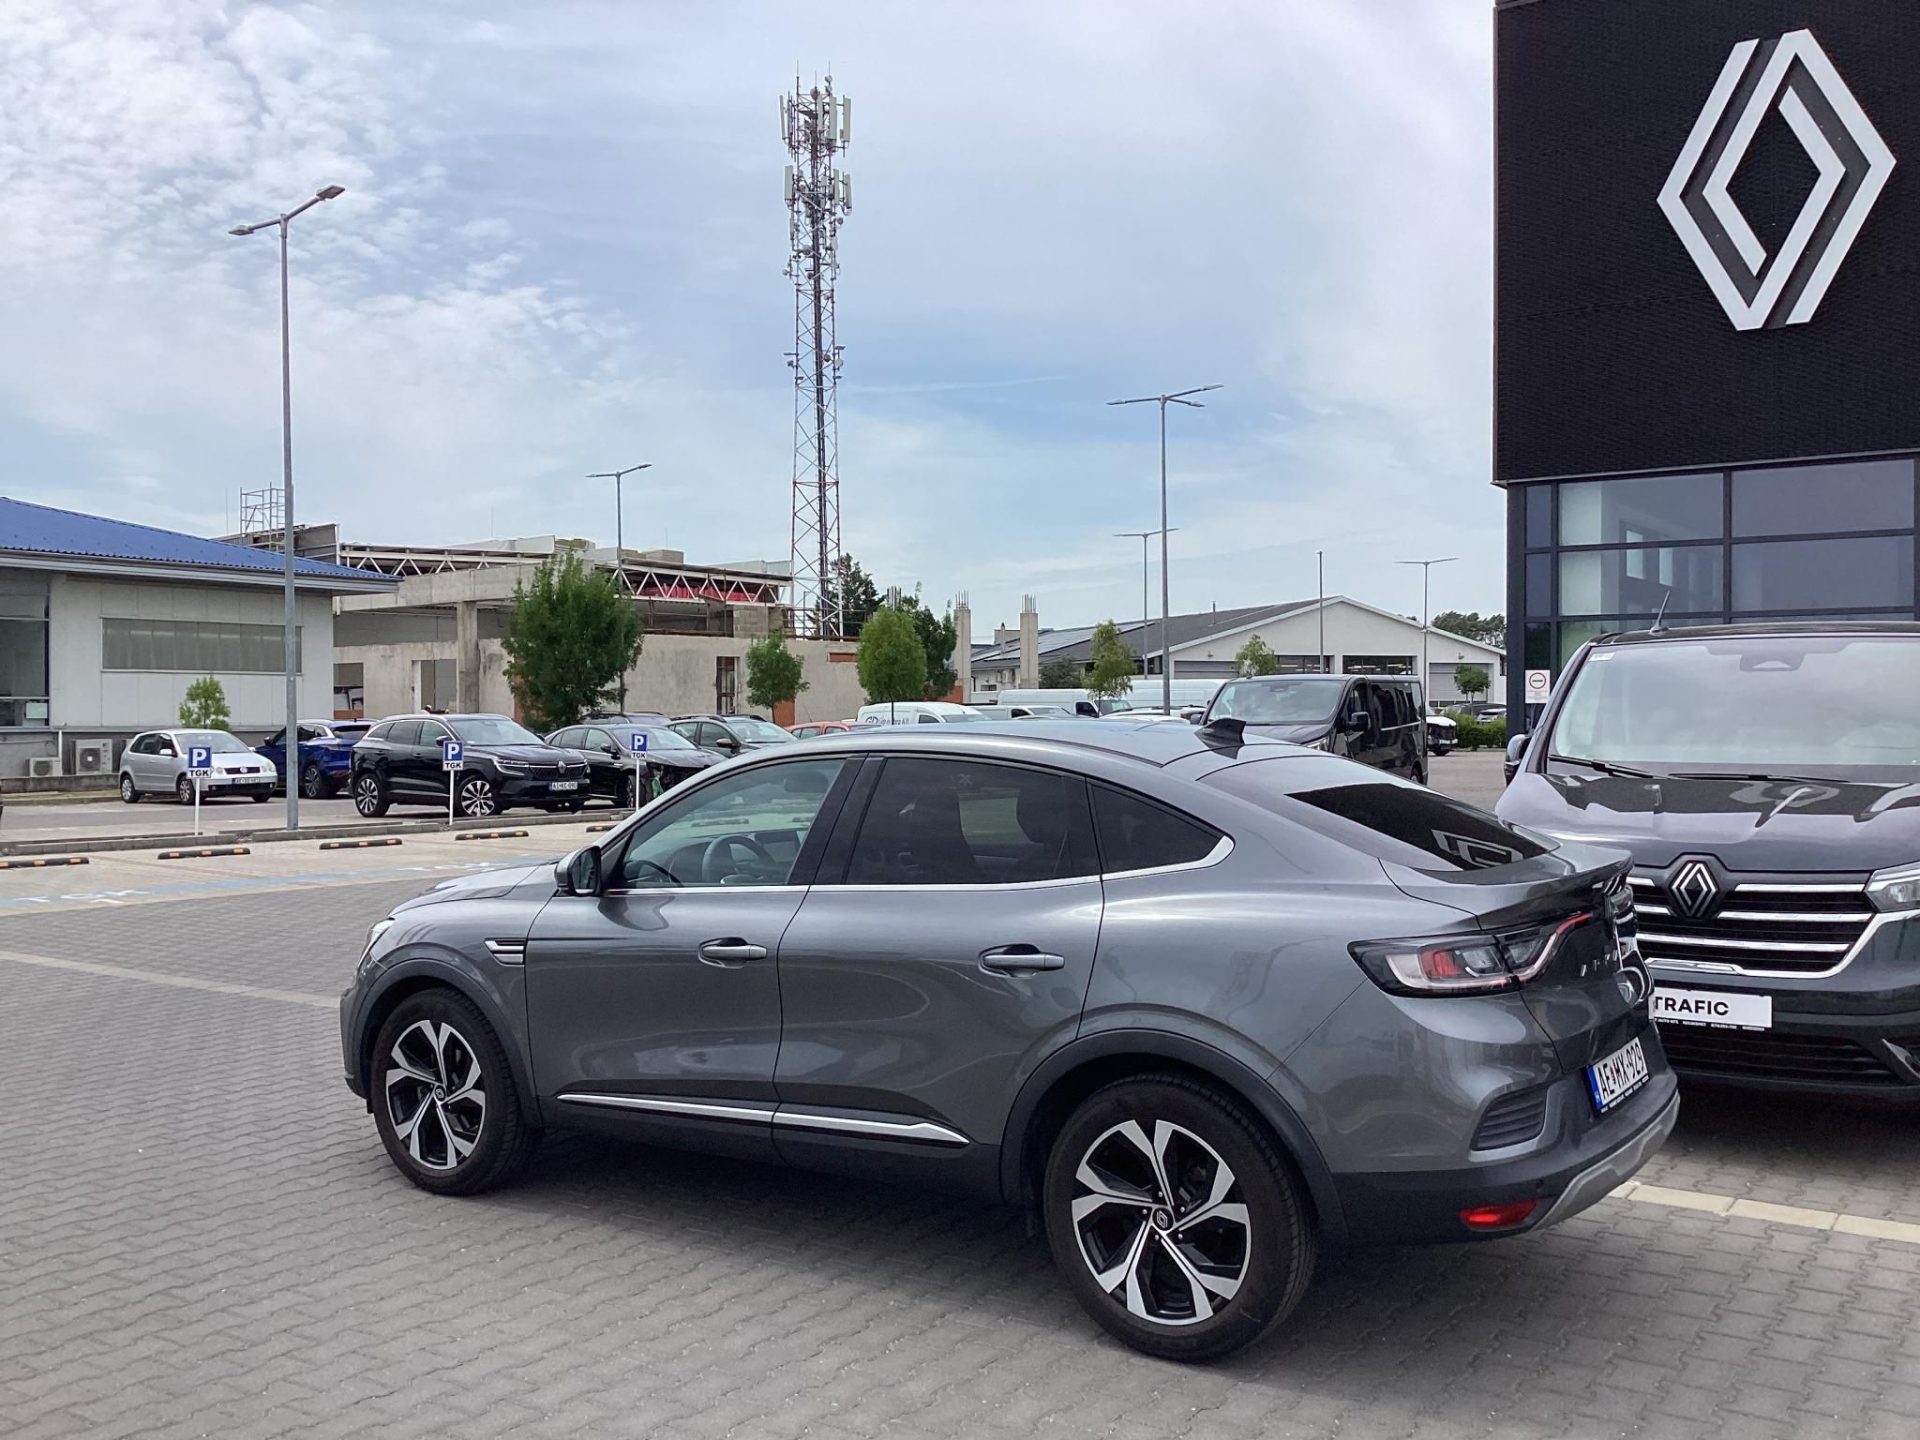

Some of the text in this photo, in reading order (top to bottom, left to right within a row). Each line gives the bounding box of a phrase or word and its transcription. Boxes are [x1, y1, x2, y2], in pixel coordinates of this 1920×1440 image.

[634, 735, 645, 750] P
[192, 748, 207, 767] P
[447, 743, 460, 760] P
[189, 769, 209, 777] TGK
[1654, 996, 1729, 1016] TRAFIC
